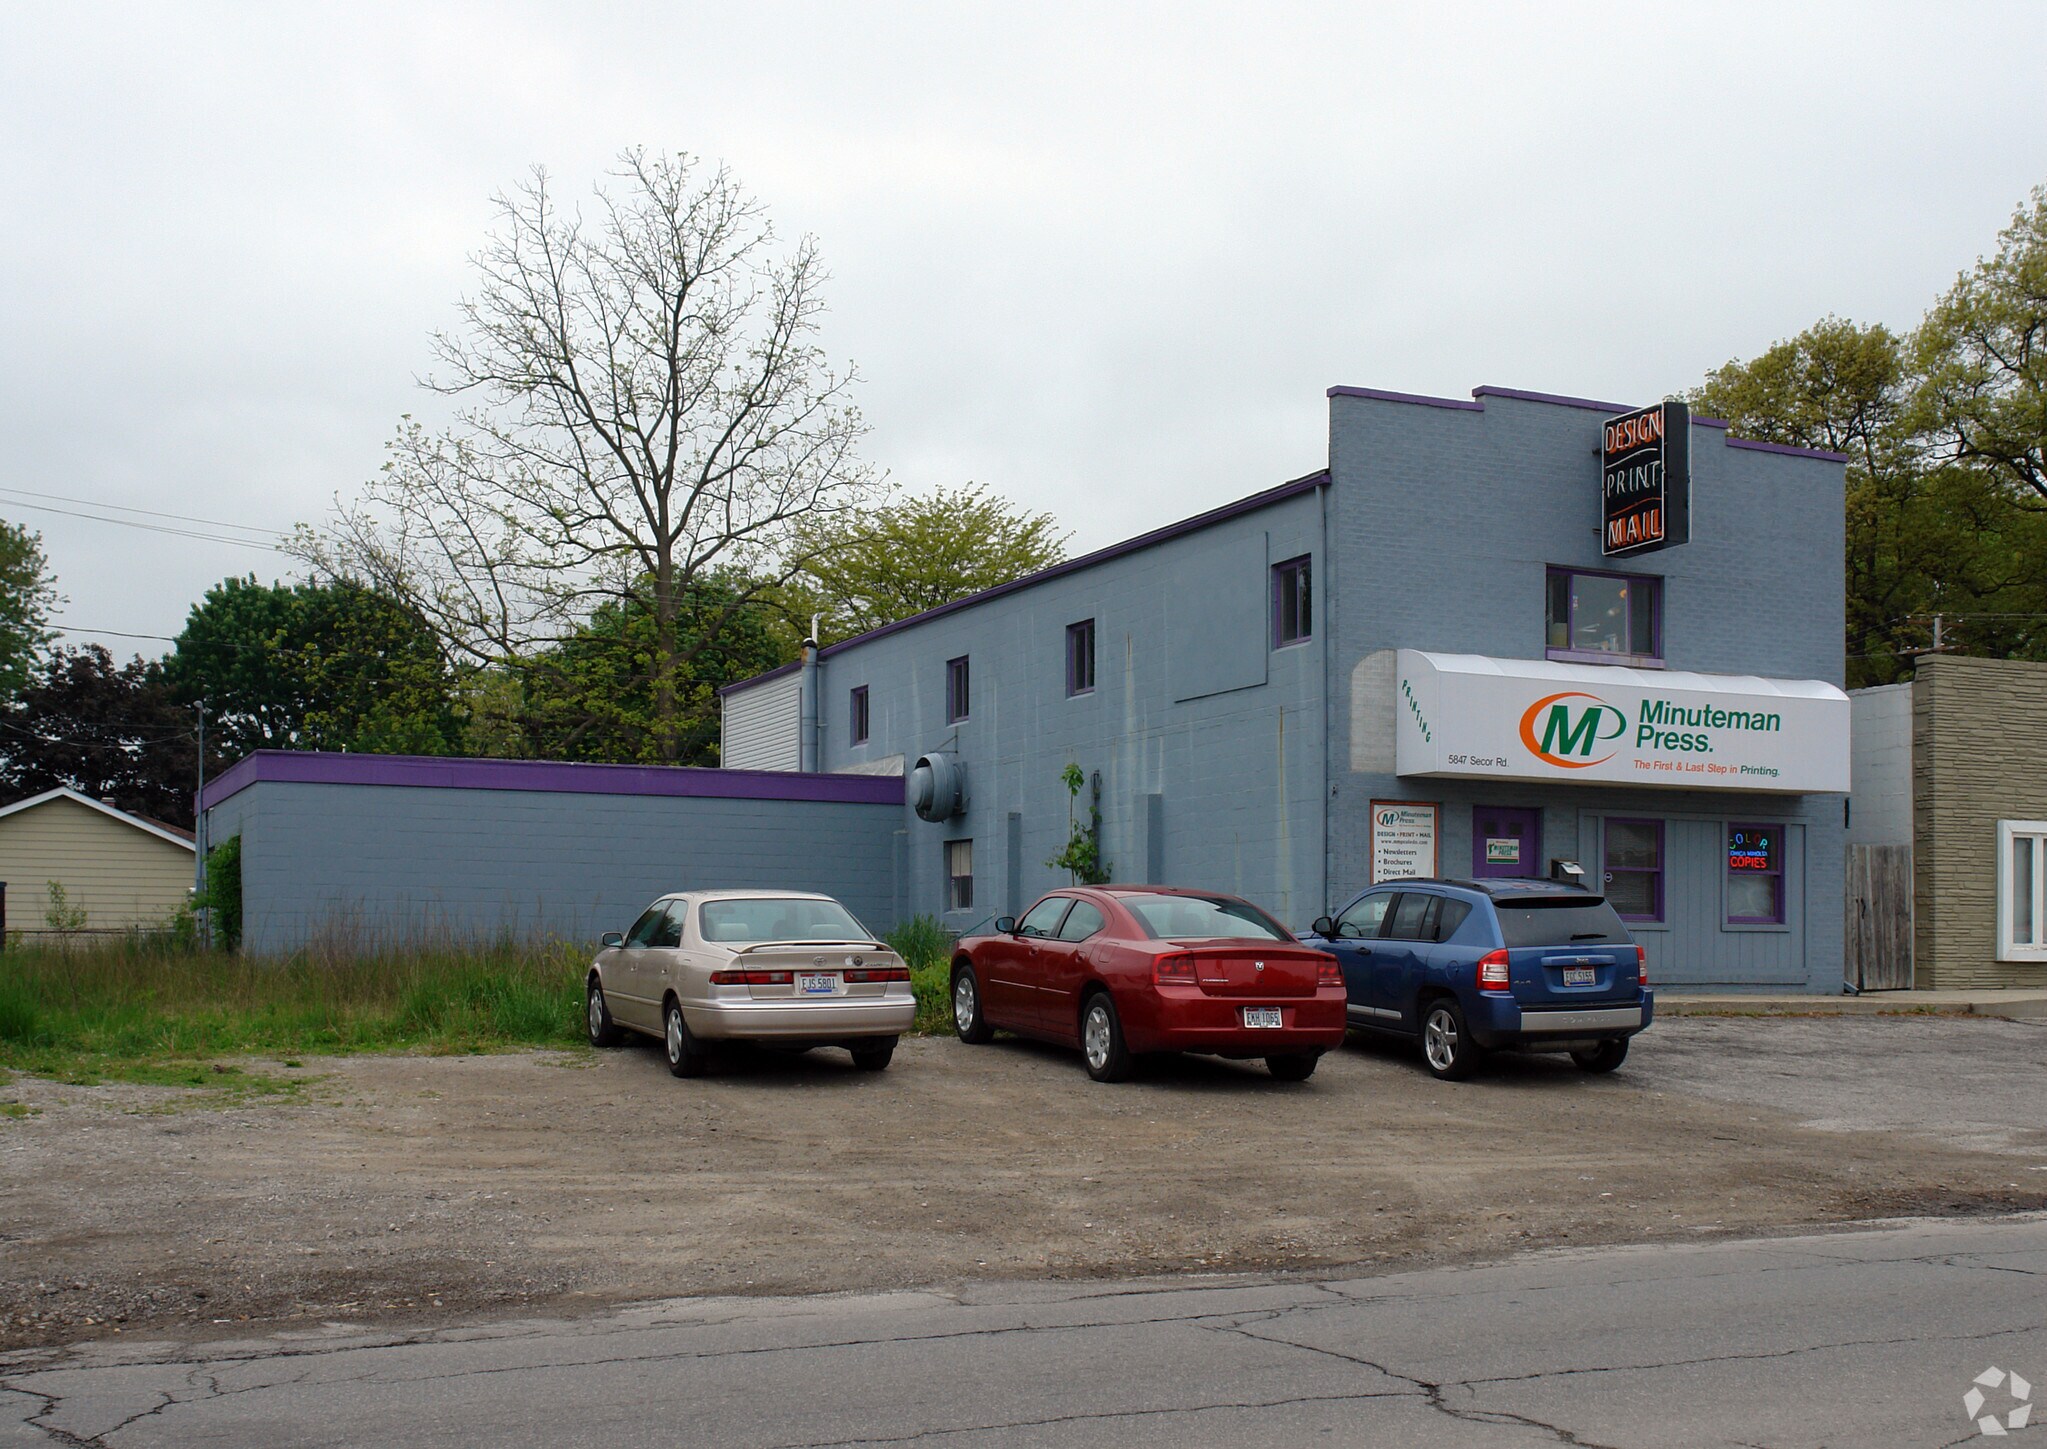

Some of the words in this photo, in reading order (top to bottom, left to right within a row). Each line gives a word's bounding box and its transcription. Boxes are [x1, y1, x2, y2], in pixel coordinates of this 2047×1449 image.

[1605, 410, 1662, 455] DESIGN
[1607, 460, 1661, 498] PRINT
[1608, 508, 1662, 548] MAIL
[1402, 679, 1431, 743] PRINTING
[1639, 699, 1781, 732] Minuteman
[1636, 724, 1714, 753] Press.
[1448, 754, 1467, 765] 5847
[1470, 755, 1493, 766] Secor
[1634, 759, 1651, 770] The
[1653, 760, 1673, 771] First
[1675, 761, 1683, 771] &
[1685, 762, 1704, 773] Last
[1707, 763, 1727, 775] Step
[1729, 764, 1738, 774] in
[1740, 765, 1781, 778] Printing.
[1383, 848, 1417, 856] Newsletters
[1383, 858, 1413, 866] Brochures
[1730, 856, 1767, 869] COPIES
[802, 978, 816, 989] EJS
[817, 978, 836, 989] 5801
